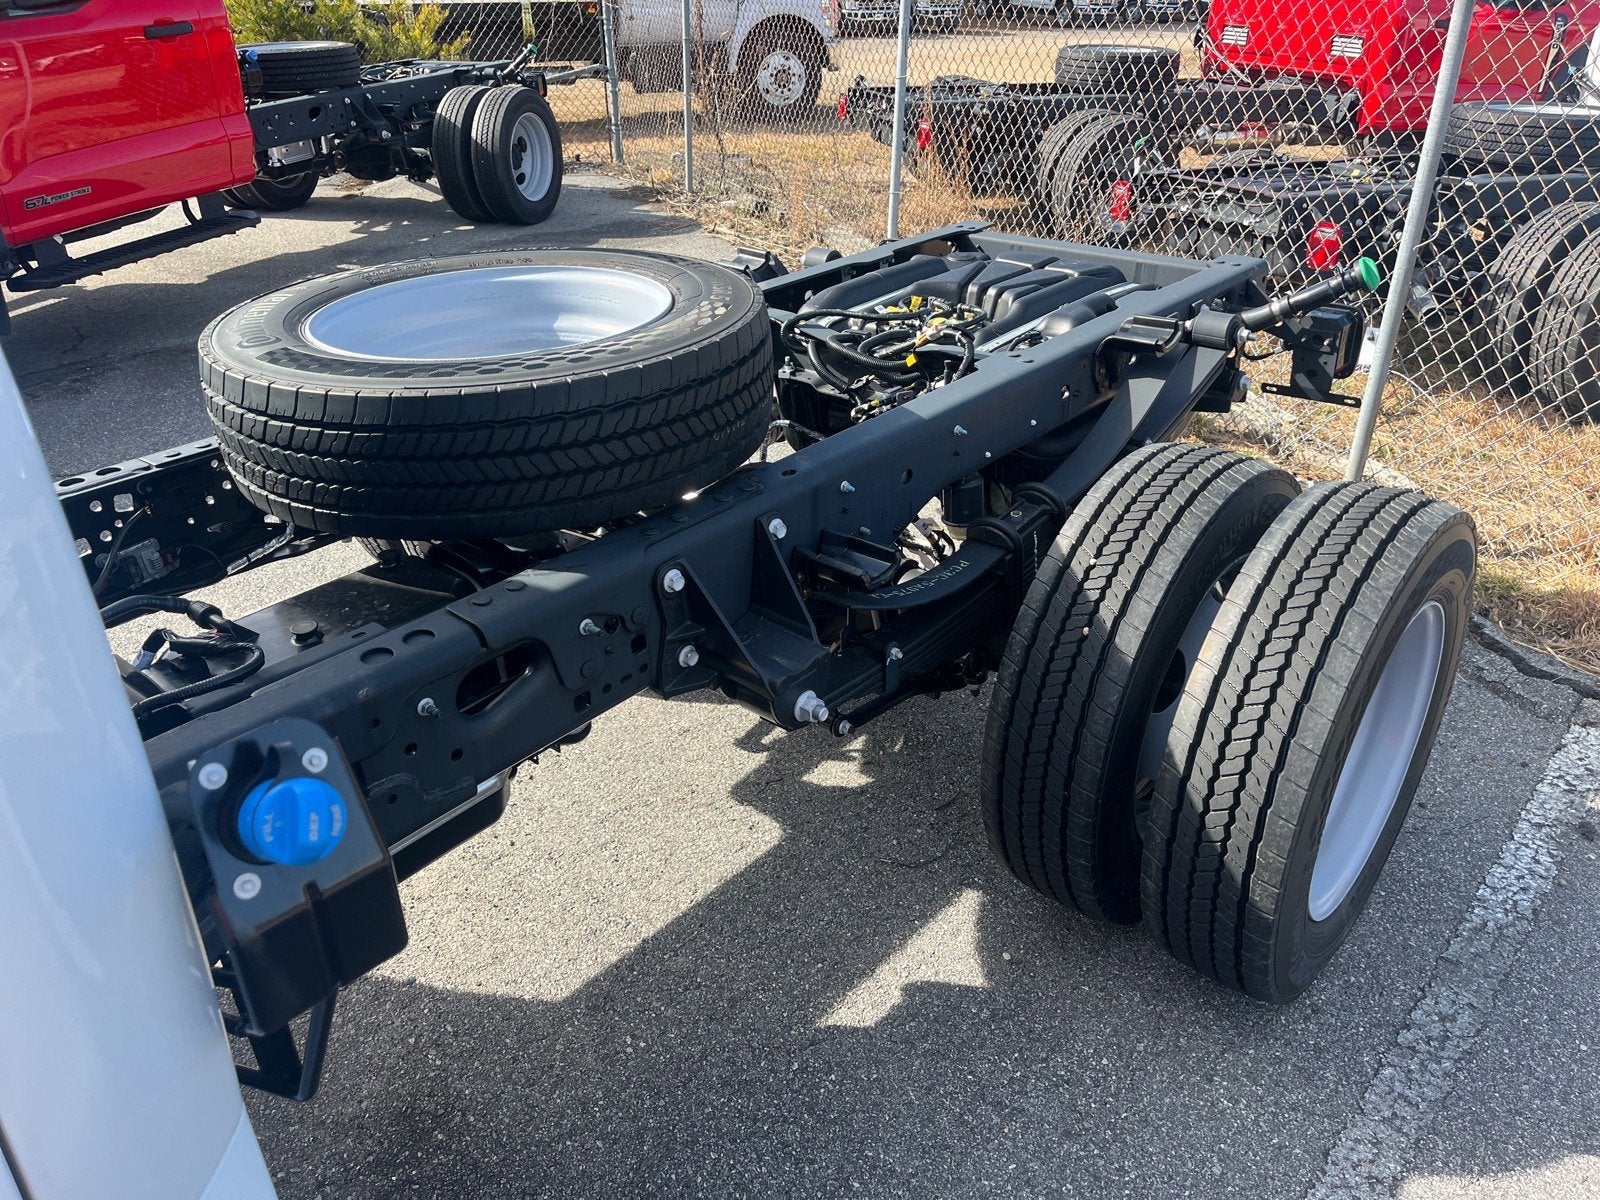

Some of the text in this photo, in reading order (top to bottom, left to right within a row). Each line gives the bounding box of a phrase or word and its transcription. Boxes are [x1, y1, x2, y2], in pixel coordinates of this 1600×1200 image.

[50, 193, 70, 202] POWER
[71, 187, 90, 196] STROKE
[309, 811, 319, 842] DEF
[331, 803, 342, 836] HERE
